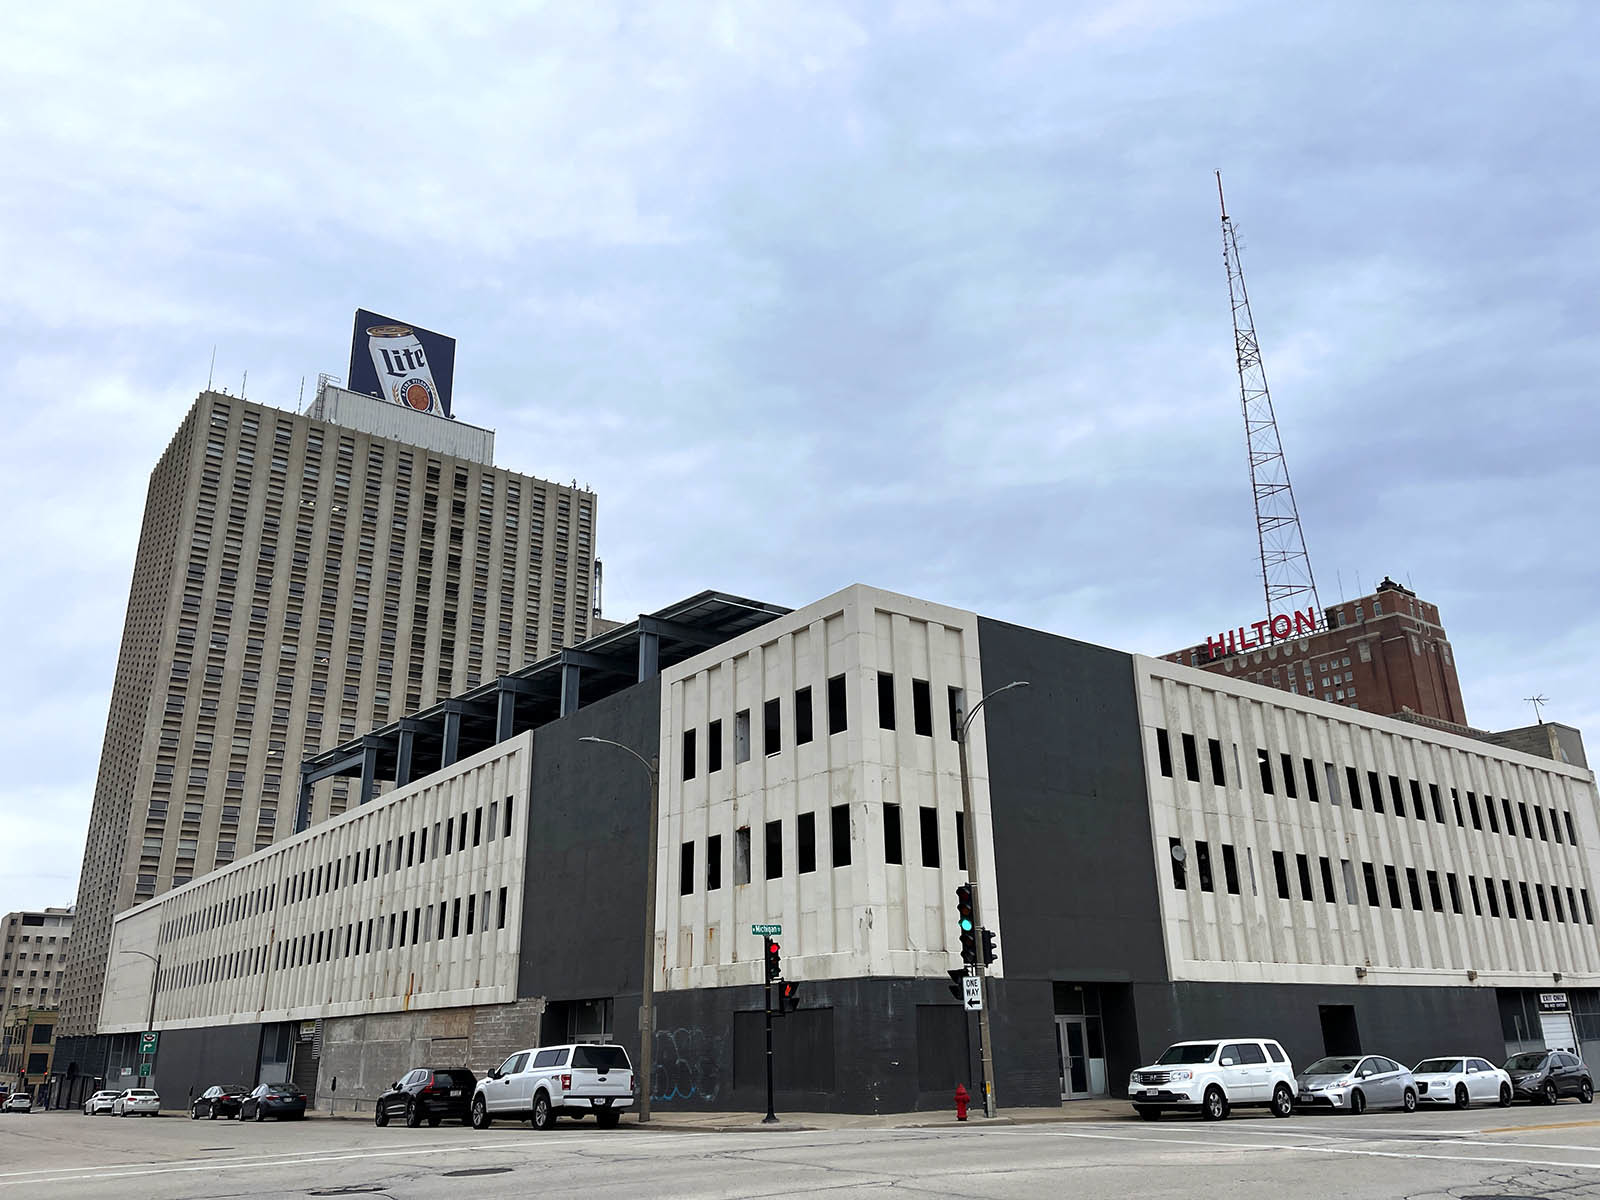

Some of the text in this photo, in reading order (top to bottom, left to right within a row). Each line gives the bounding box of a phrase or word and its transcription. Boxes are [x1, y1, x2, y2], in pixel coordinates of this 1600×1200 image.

[378, 348, 425, 378] Lite
[1207, 606, 1316, 660] HILTON
[755, 924, 777, 935] Michigan
[966, 979, 978, 987] ONE
[966, 988, 979, 996] WAY
